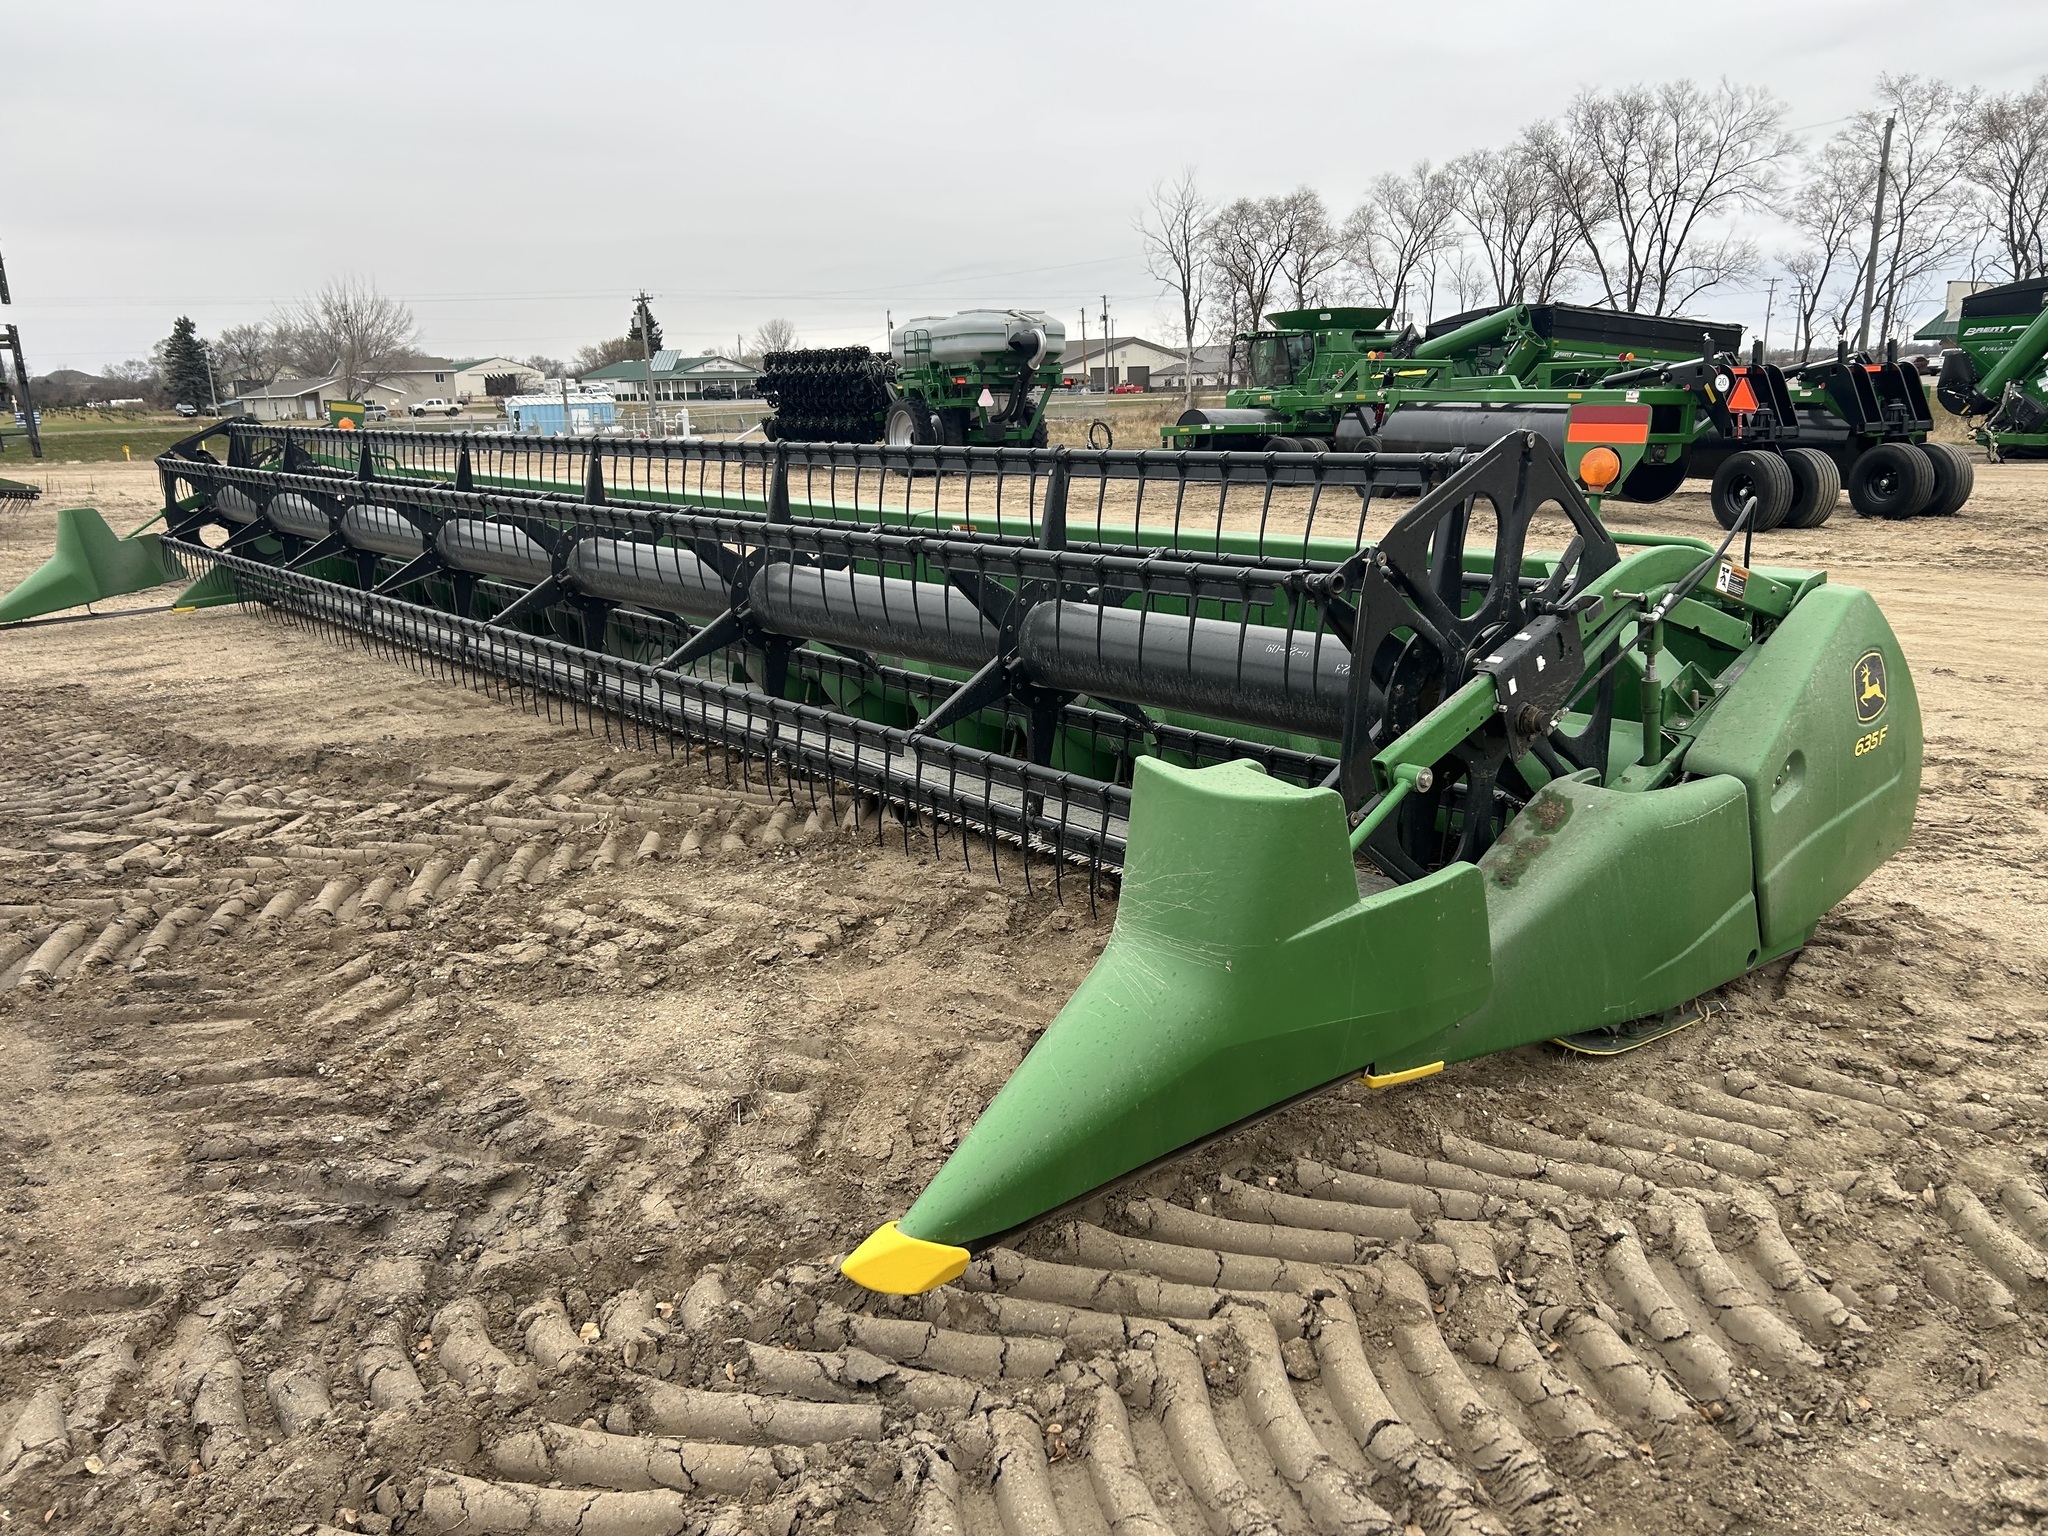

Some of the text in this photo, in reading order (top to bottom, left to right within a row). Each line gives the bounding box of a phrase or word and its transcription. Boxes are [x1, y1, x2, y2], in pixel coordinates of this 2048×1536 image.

[1963, 326, 2007, 336] BRENT
[1717, 377, 1728, 387] 20
[1854, 725, 1889, 757] 635F
